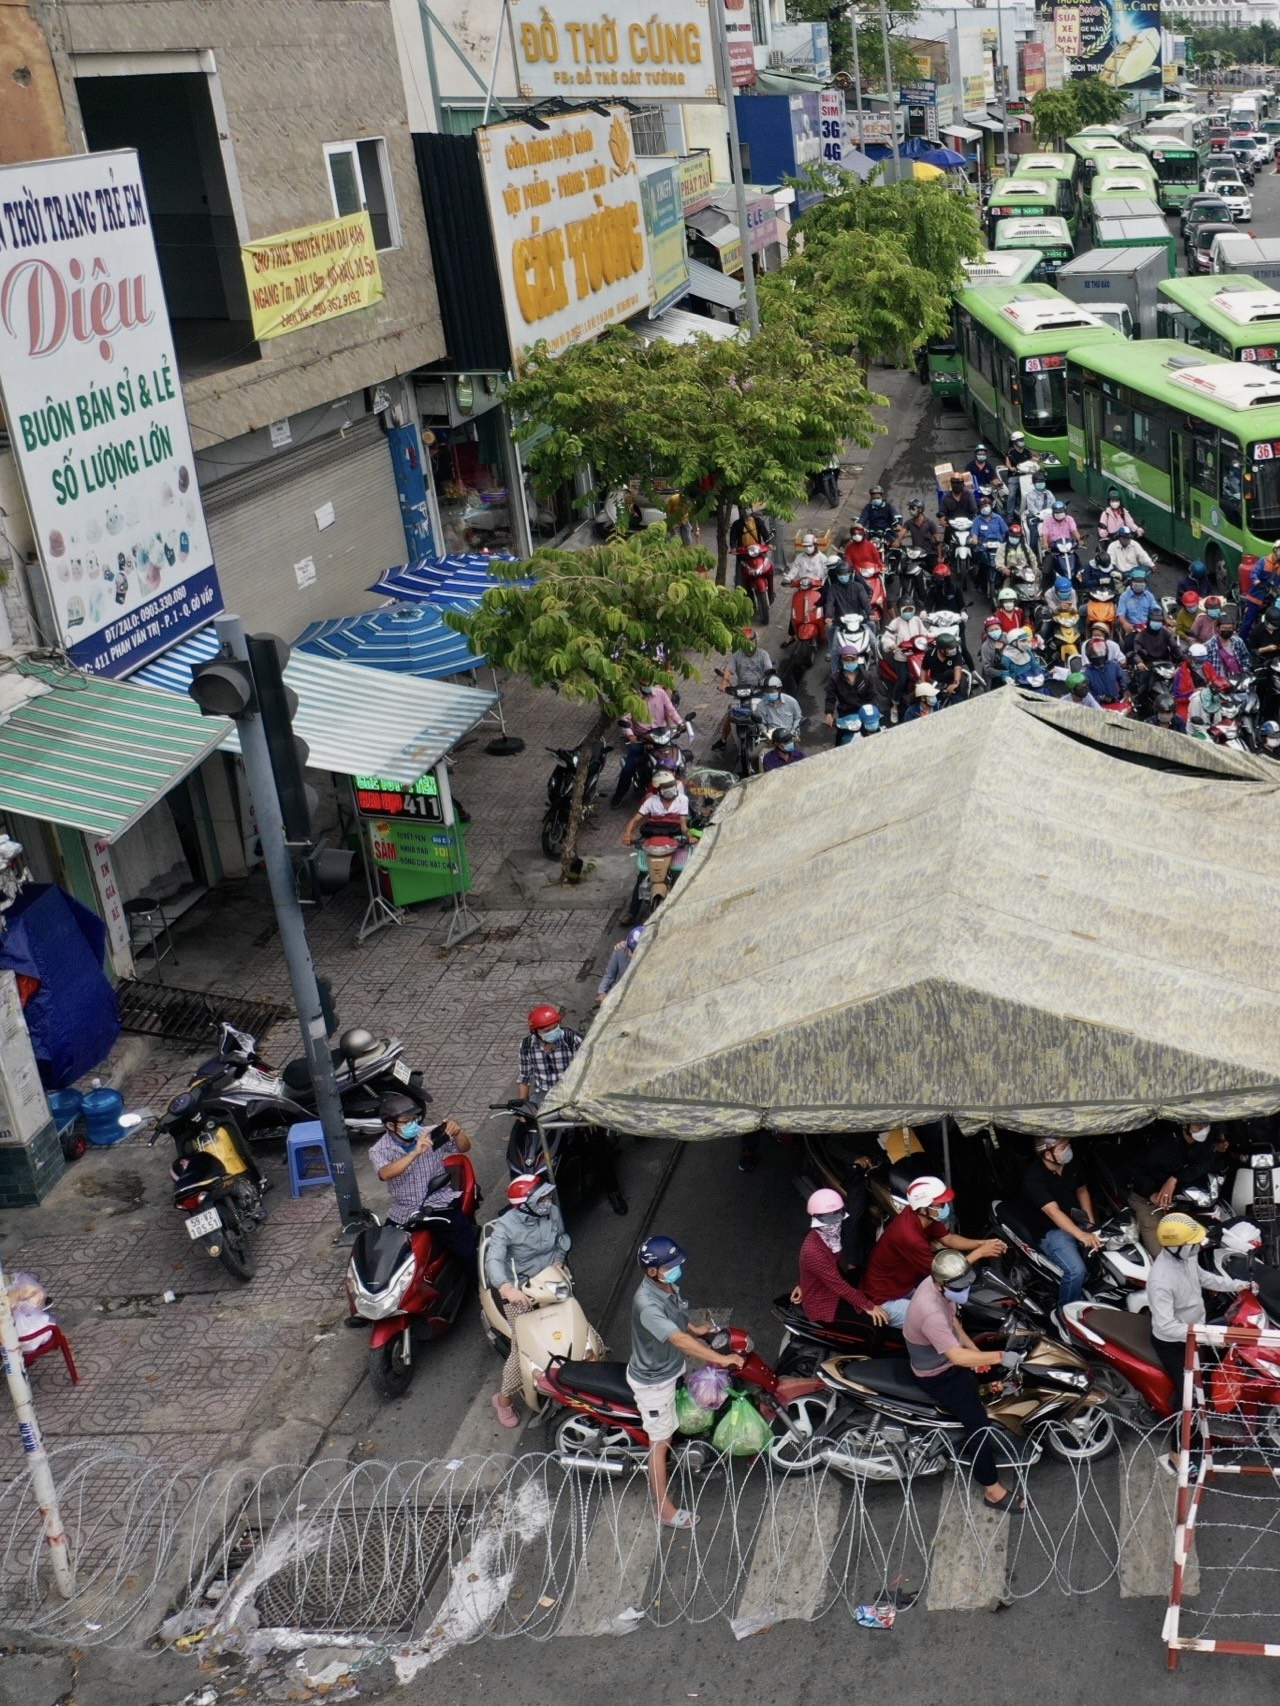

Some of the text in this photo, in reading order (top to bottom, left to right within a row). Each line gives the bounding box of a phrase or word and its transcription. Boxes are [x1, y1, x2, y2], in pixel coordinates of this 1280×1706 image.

[1115, 0, 1159, 12] Dr.Care
[520, 6, 702, 64] ĐỒ THỜ CÚNG
[553, 71, 574, 85] FB:
[576, 66, 592, 85] ĐỒ
[595, 69, 619, 85] THỜ
[645, 69, 686, 86] TƯỜNG
[821, 106, 839, 117] SIM
[822, 120, 840, 139] 3G
[823, 142, 842, 161] 4G
[680, 174, 699, 198] PHÁT
[2, 166, 147, 249] THỜI TRANG TRẺ EM
[252, 249, 270, 274] CHO
[271, 239, 292, 270] THUÊ
[291, 231, 322, 261] NGUYÊN
[512, 215, 570, 325] CÁT
[252, 283, 281, 311] NGANG
[294, 270, 309, 299] DÀI
[1084, 280, 1091, 289] XE
[2, 257, 154, 362] Diệu
[1027, 360, 1038, 371] 36
[1242, 349, 1254, 361] 36
[19, 354, 176, 453] BUÔN BÁN SỈ & LẺ
[52, 420, 174, 506] SỐ LƯỢNG LỚN
[1256, 444, 1270, 459] 36
[104, 585, 187, 644] ĐT/ZALO: 0903.330.080
[94, 651, 111, 672] 411
[109, 641, 132, 664] PHAN
[131, 629, 148, 652] VĂN
[147, 623, 161, 639] TRỊ
[164, 616, 174, 629] P.
[173, 611, 179, 623] 1
[182, 603, 191, 618] Q.
[190, 593, 201, 612] GÒ
[200, 585, 214, 606] VẤP
[403, 794, 439, 817] 411
